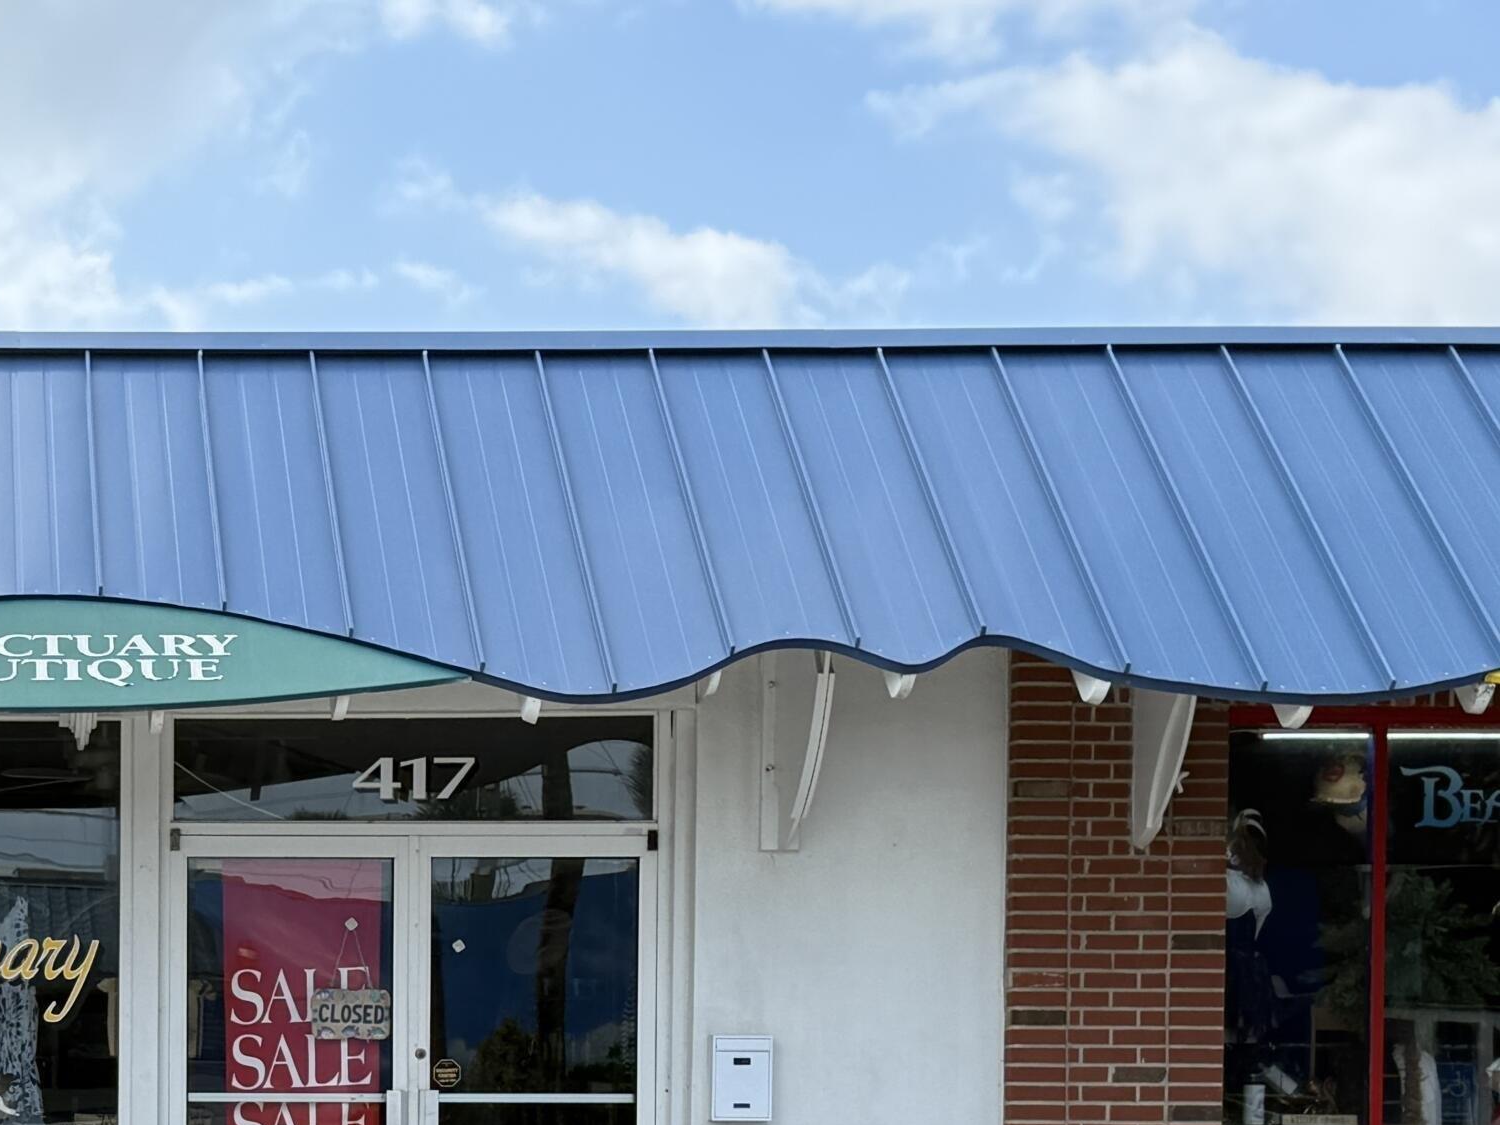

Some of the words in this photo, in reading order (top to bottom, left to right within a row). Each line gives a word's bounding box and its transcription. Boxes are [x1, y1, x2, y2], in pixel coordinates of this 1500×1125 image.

[352, 757, 476, 800] 417
[318, 1004, 386, 1025] CLOSED
[231, 1033, 373, 1091] SALE
